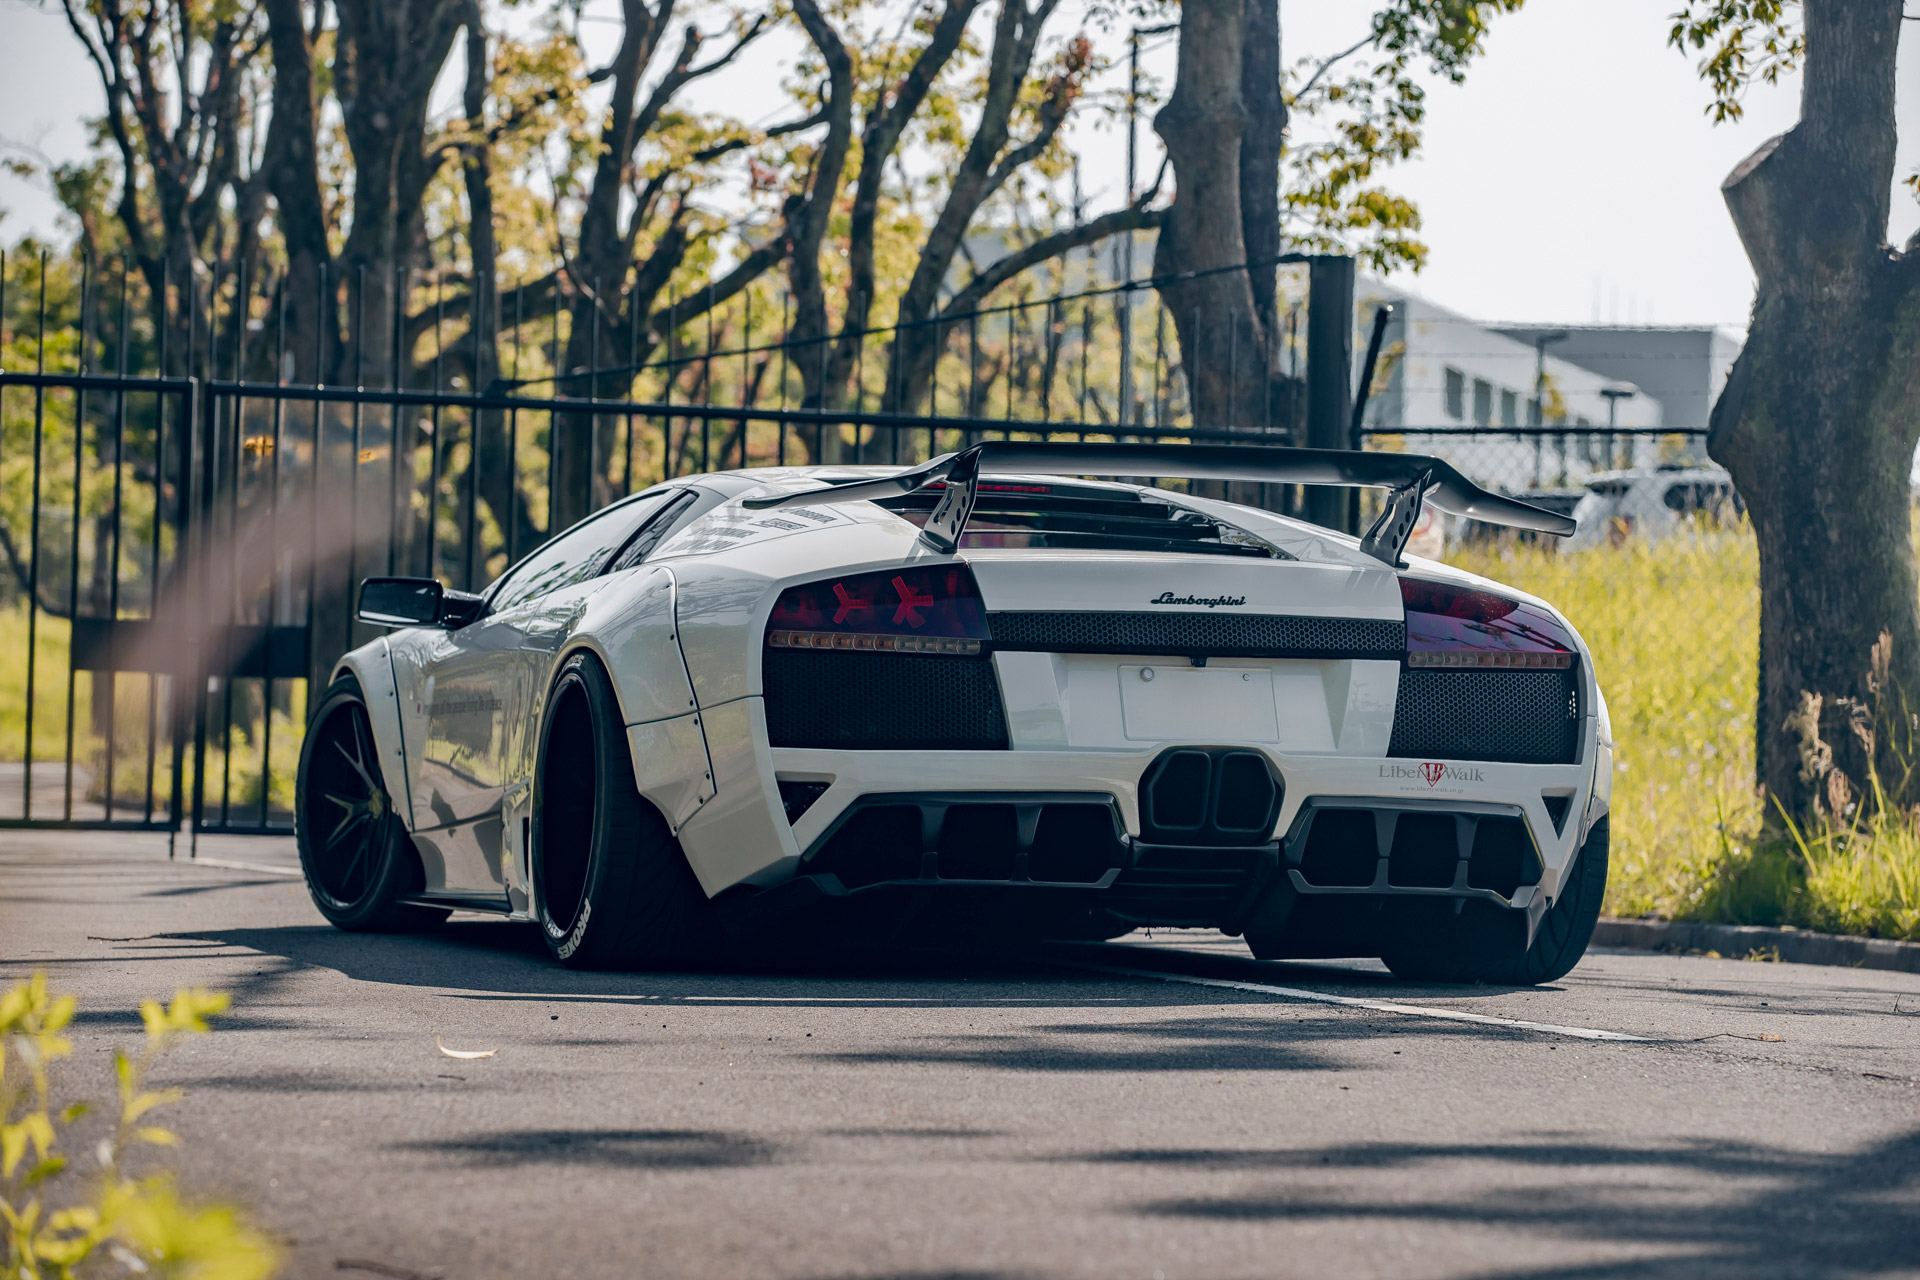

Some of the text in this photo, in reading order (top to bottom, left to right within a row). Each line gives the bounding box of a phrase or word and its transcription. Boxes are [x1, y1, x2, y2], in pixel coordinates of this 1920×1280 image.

[1150, 591, 1247, 608] Lamborghini
[1443, 767, 1485, 781] Walk
[1400, 785, 1464, 794] www.libertywalk.co.jp
[557, 897, 592, 960] PROXES
